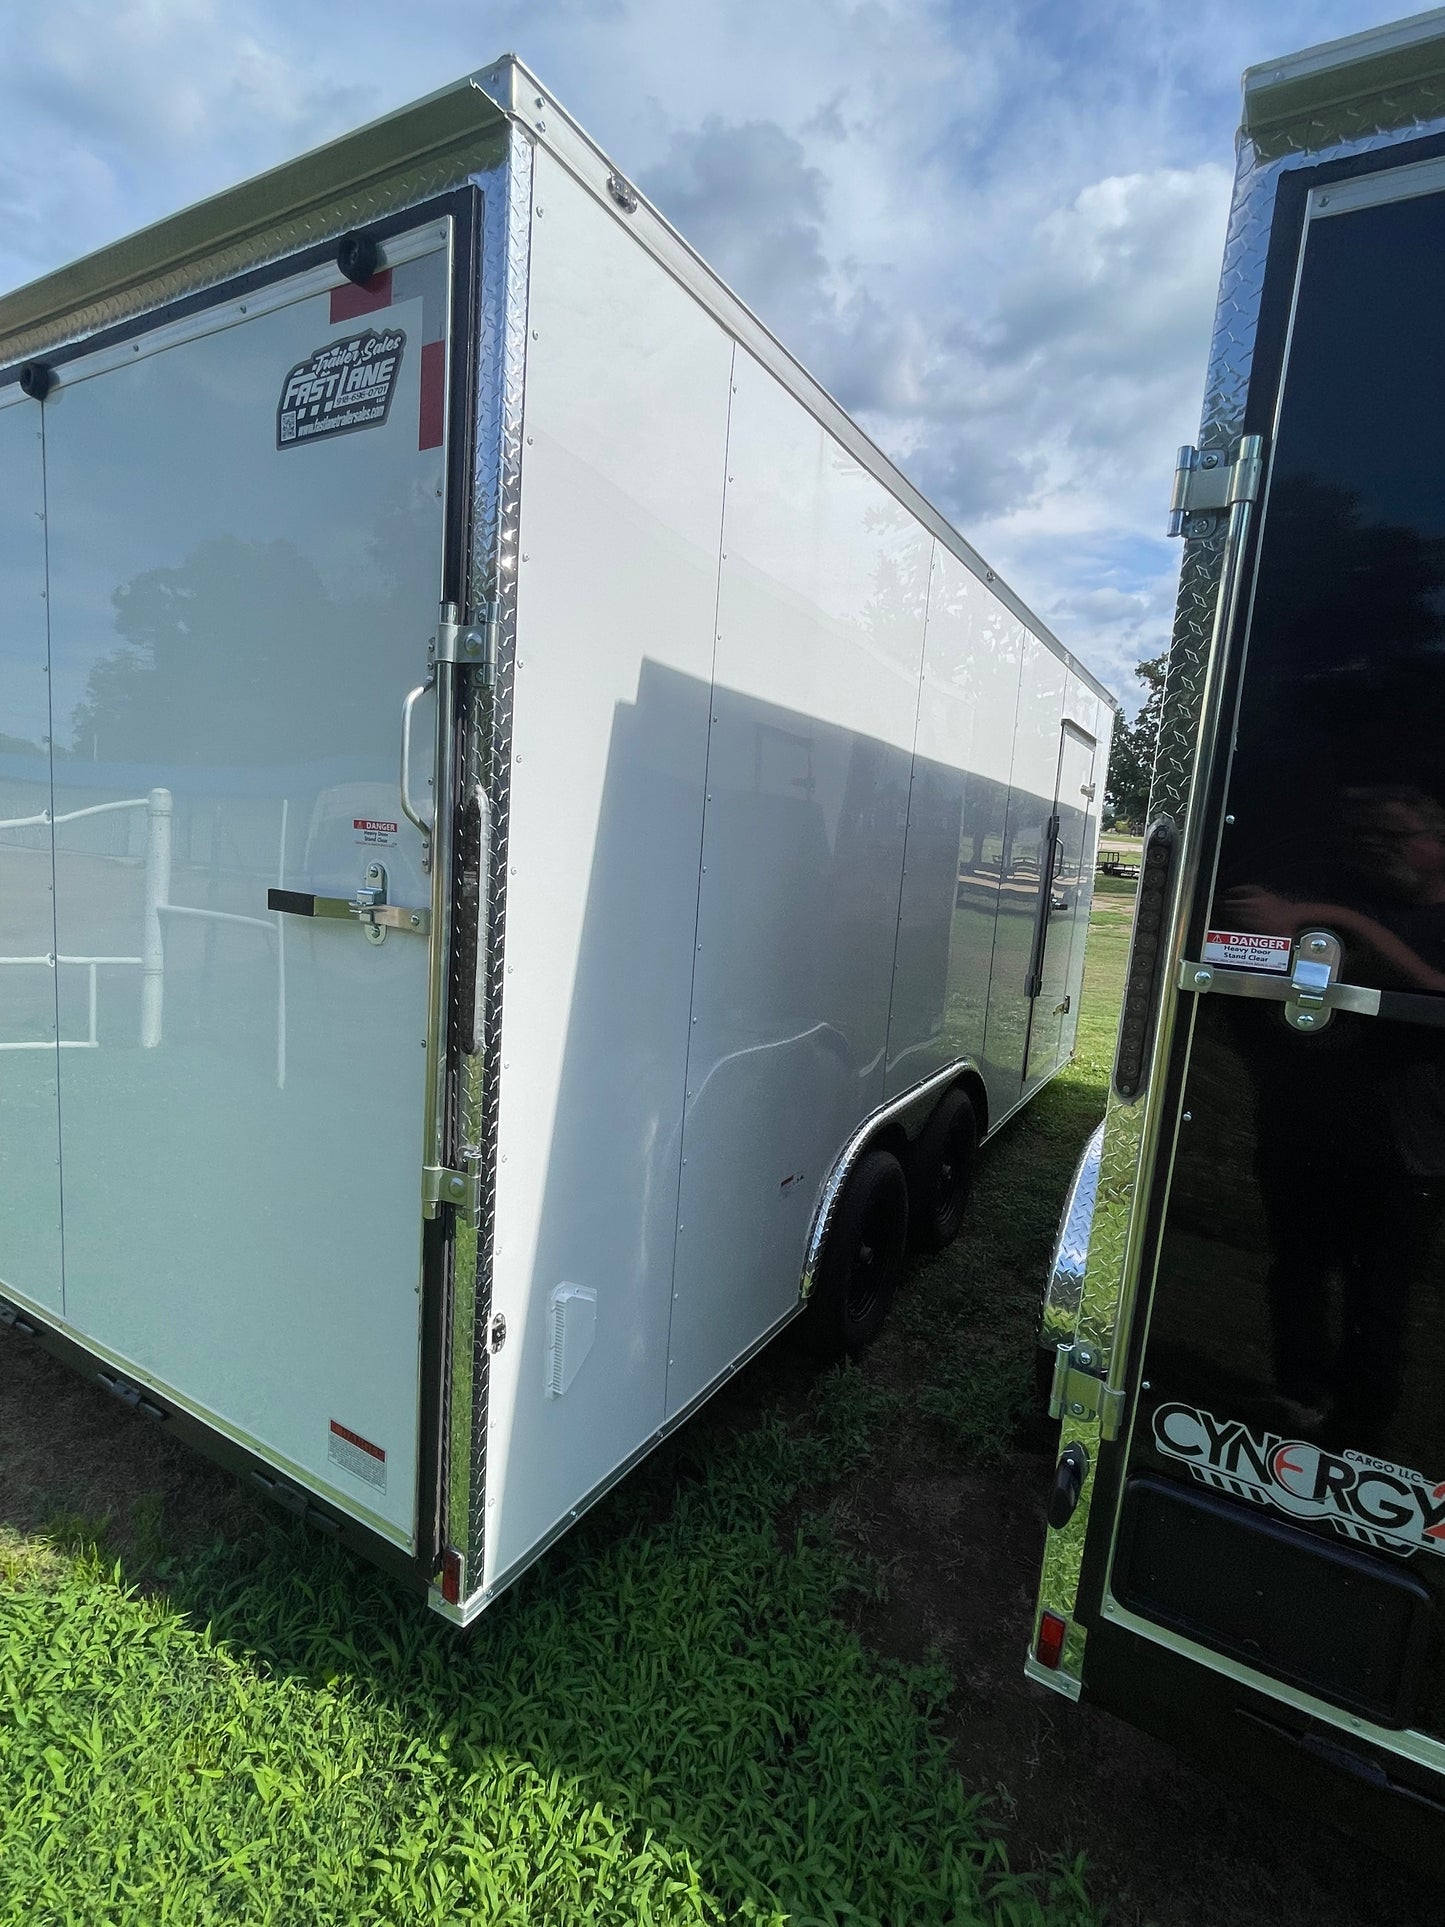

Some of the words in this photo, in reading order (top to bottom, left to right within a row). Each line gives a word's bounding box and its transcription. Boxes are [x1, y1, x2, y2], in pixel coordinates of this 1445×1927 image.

[315, 349, 362, 374] Trailer
[362, 336, 402, 360] Sales
[283, 373, 340, 410] FAST
[334, 357, 396, 407] LANE
[366, 822, 396, 831] DANGER
[1224, 945, 1249, 954] Heavy
[1229, 936, 1284, 949] DANGER
[1345, 1451, 1395, 1473] CARGO
[1399, 1469, 1421, 1483] LLC
